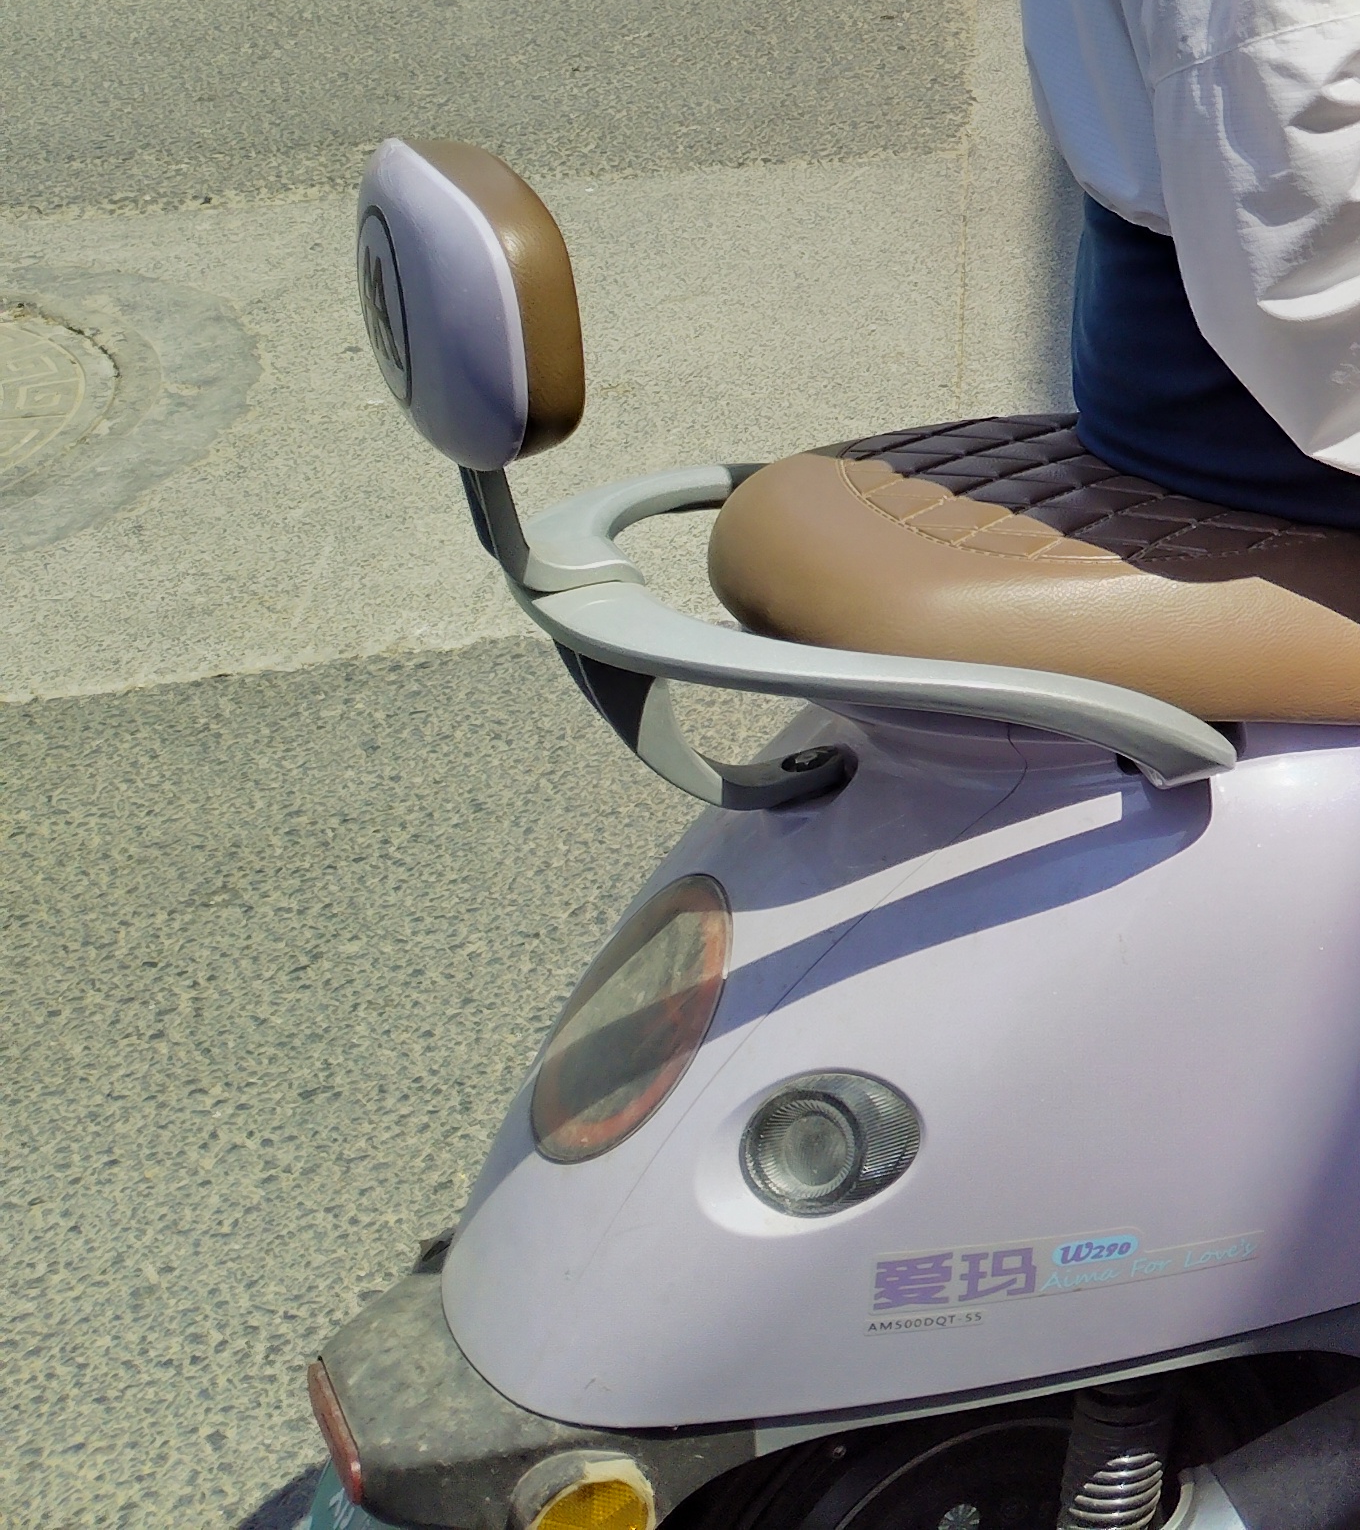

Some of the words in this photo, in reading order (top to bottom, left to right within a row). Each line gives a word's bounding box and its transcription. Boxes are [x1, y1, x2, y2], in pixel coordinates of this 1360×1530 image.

[873, 1246, 1037, 1311] 爱玛
[1039, 1268, 1121, 1293] Aima
[1130, 1256, 1172, 1278] For
[1184, 1237, 1259, 1269] Love's
[1059, 1240, 1132, 1266] W290
